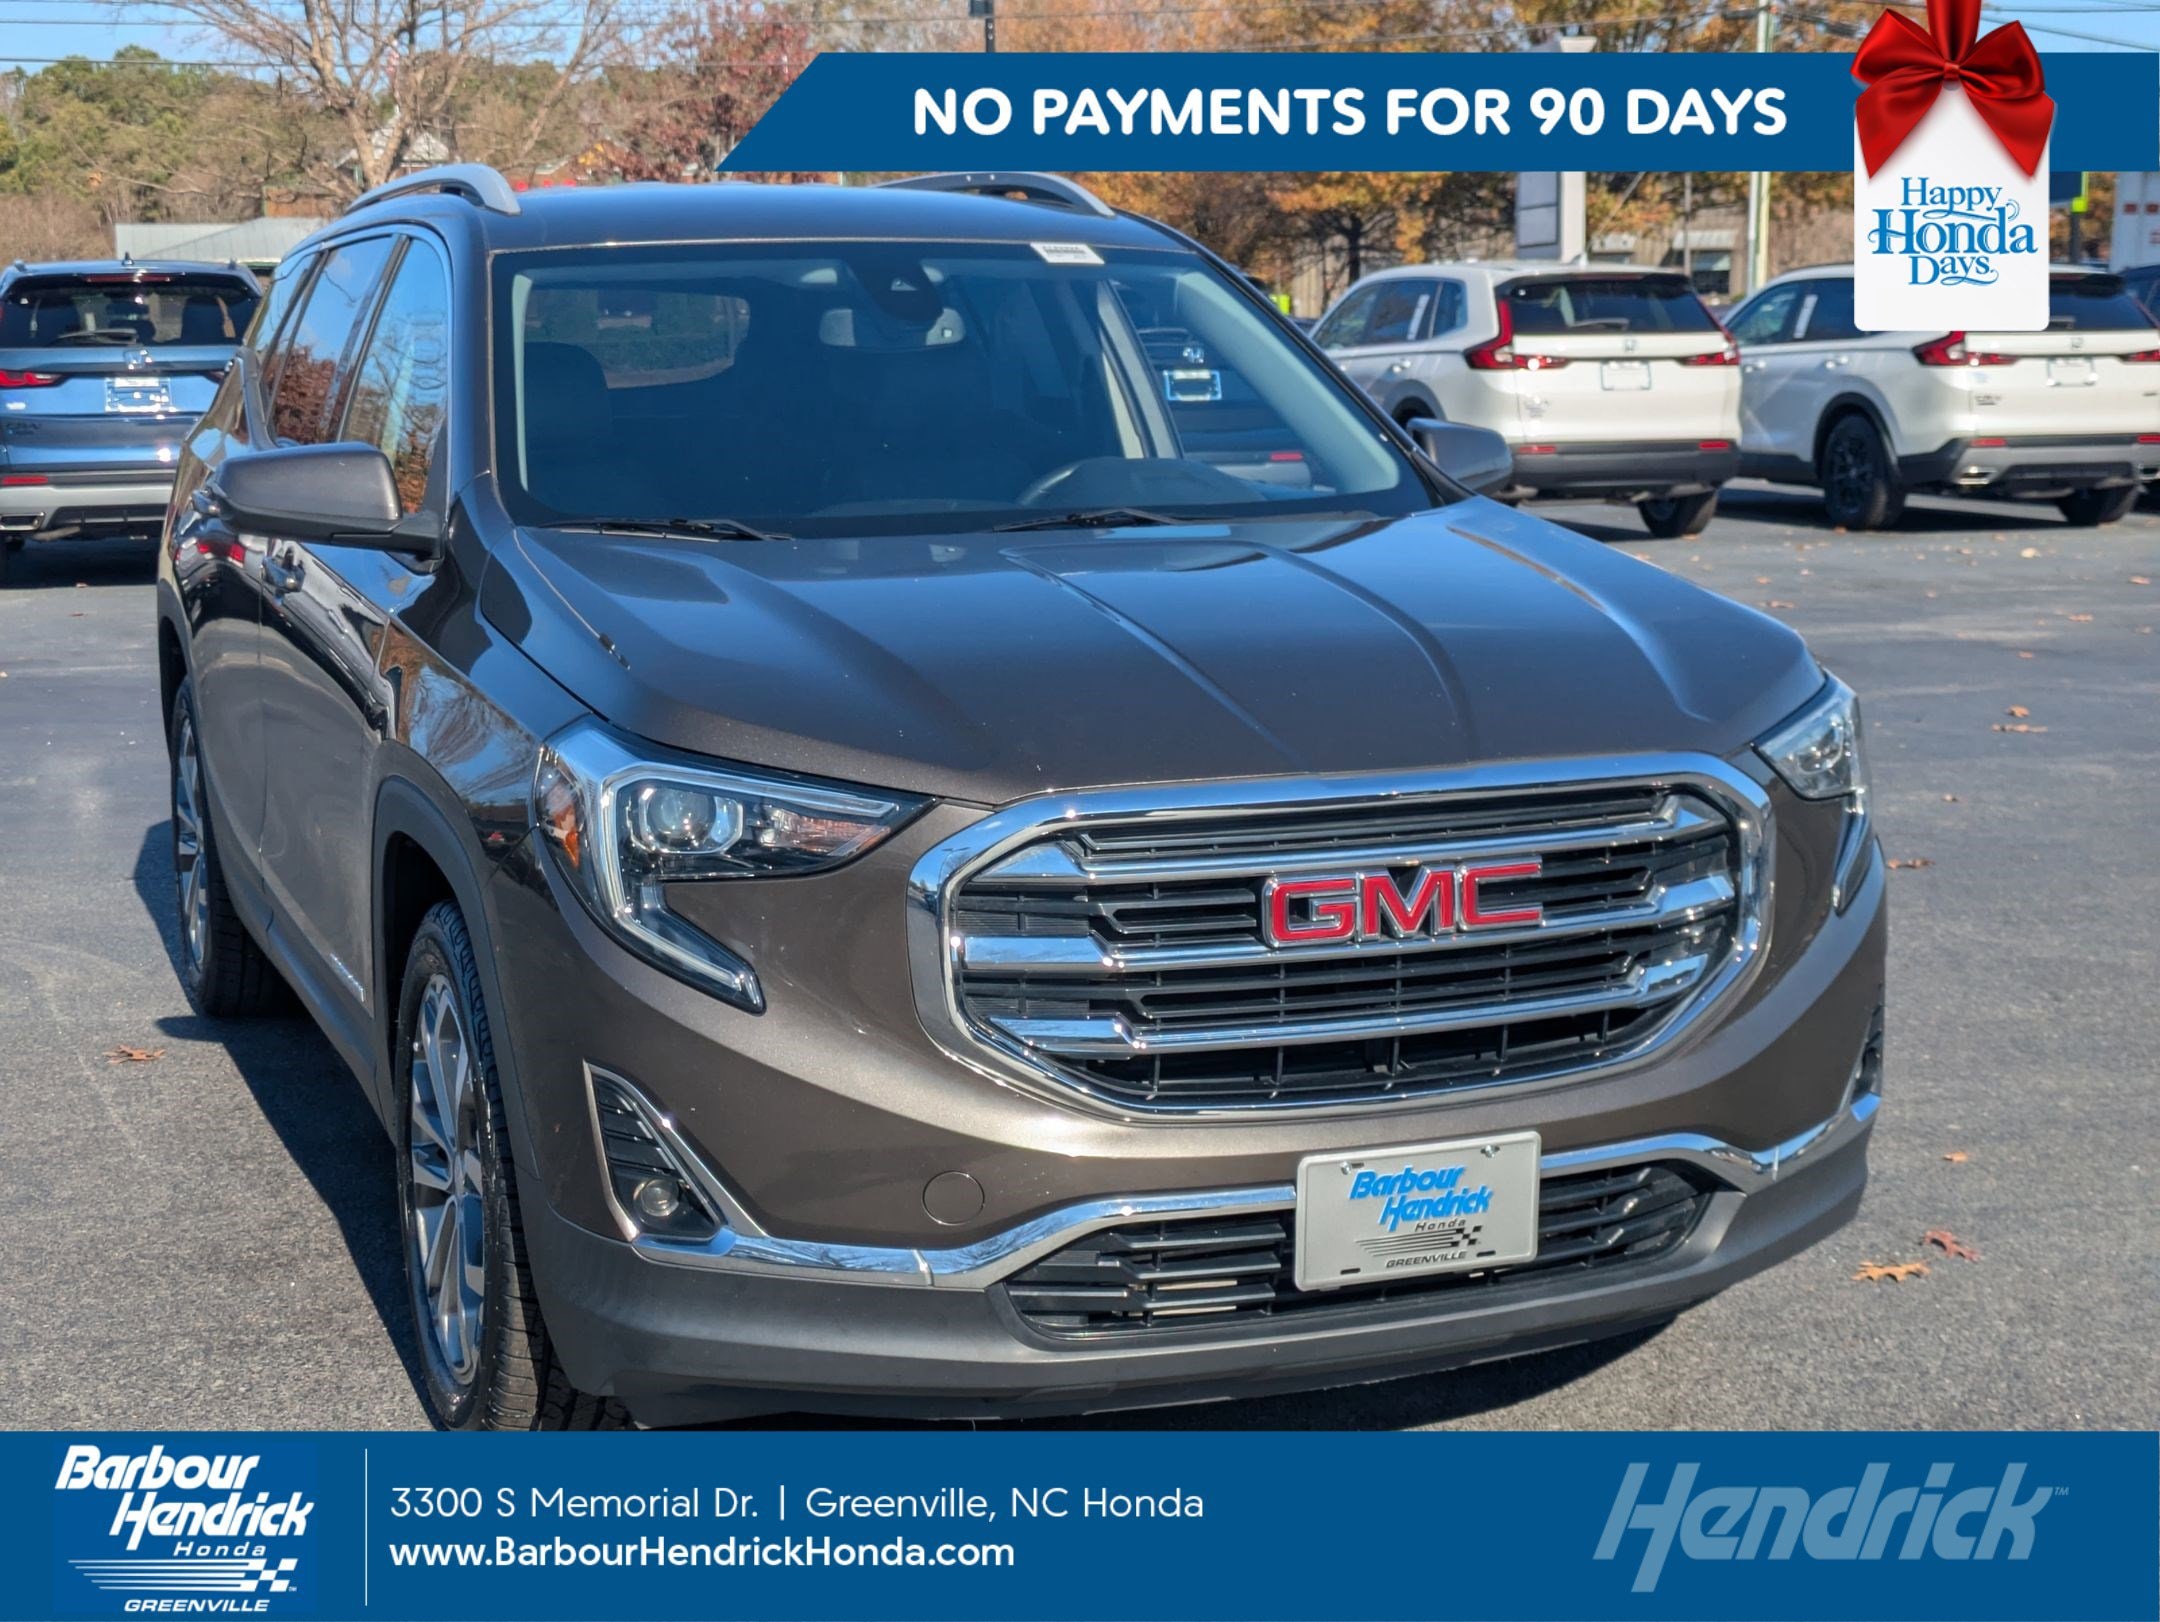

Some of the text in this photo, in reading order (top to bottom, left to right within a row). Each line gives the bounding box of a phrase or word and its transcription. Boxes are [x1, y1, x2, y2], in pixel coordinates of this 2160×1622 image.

[1262, 855, 1543, 948] GMC
[1349, 1165, 1466, 1200] Barbour
[1378, 1185, 1493, 1232] Hendrick
[1415, 1219, 1467, 1232] Honda
[1385, 1250, 1468, 1269] GREENVILLE
